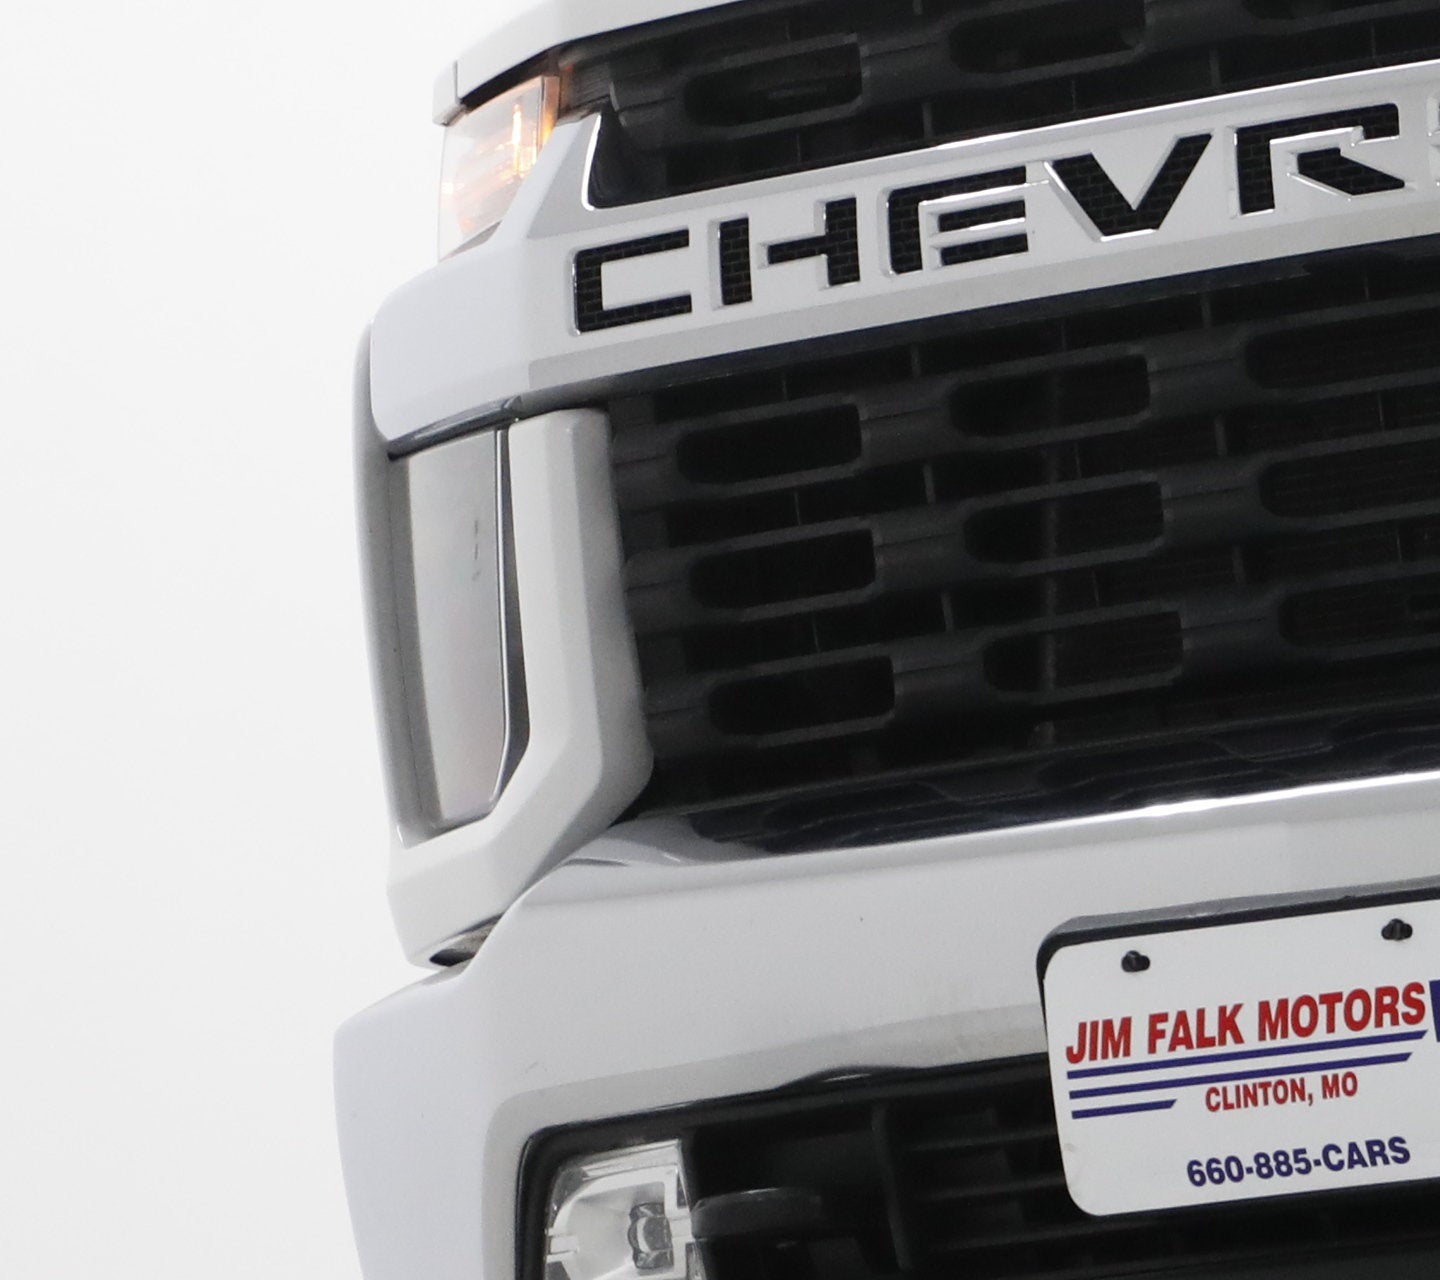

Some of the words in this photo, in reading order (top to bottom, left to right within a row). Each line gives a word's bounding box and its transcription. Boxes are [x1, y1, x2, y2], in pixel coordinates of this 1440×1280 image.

[1065, 1017, 1132, 1064] JIM
[1147, 1003, 1245, 1055] FALK
[1257, 981, 1427, 1042] MOTORS
[1205, 1077, 1313, 1113] CLINTON,
[1321, 1071, 1359, 1099] MO
[1186, 1135, 1411, 1187] 660-885-CARS
